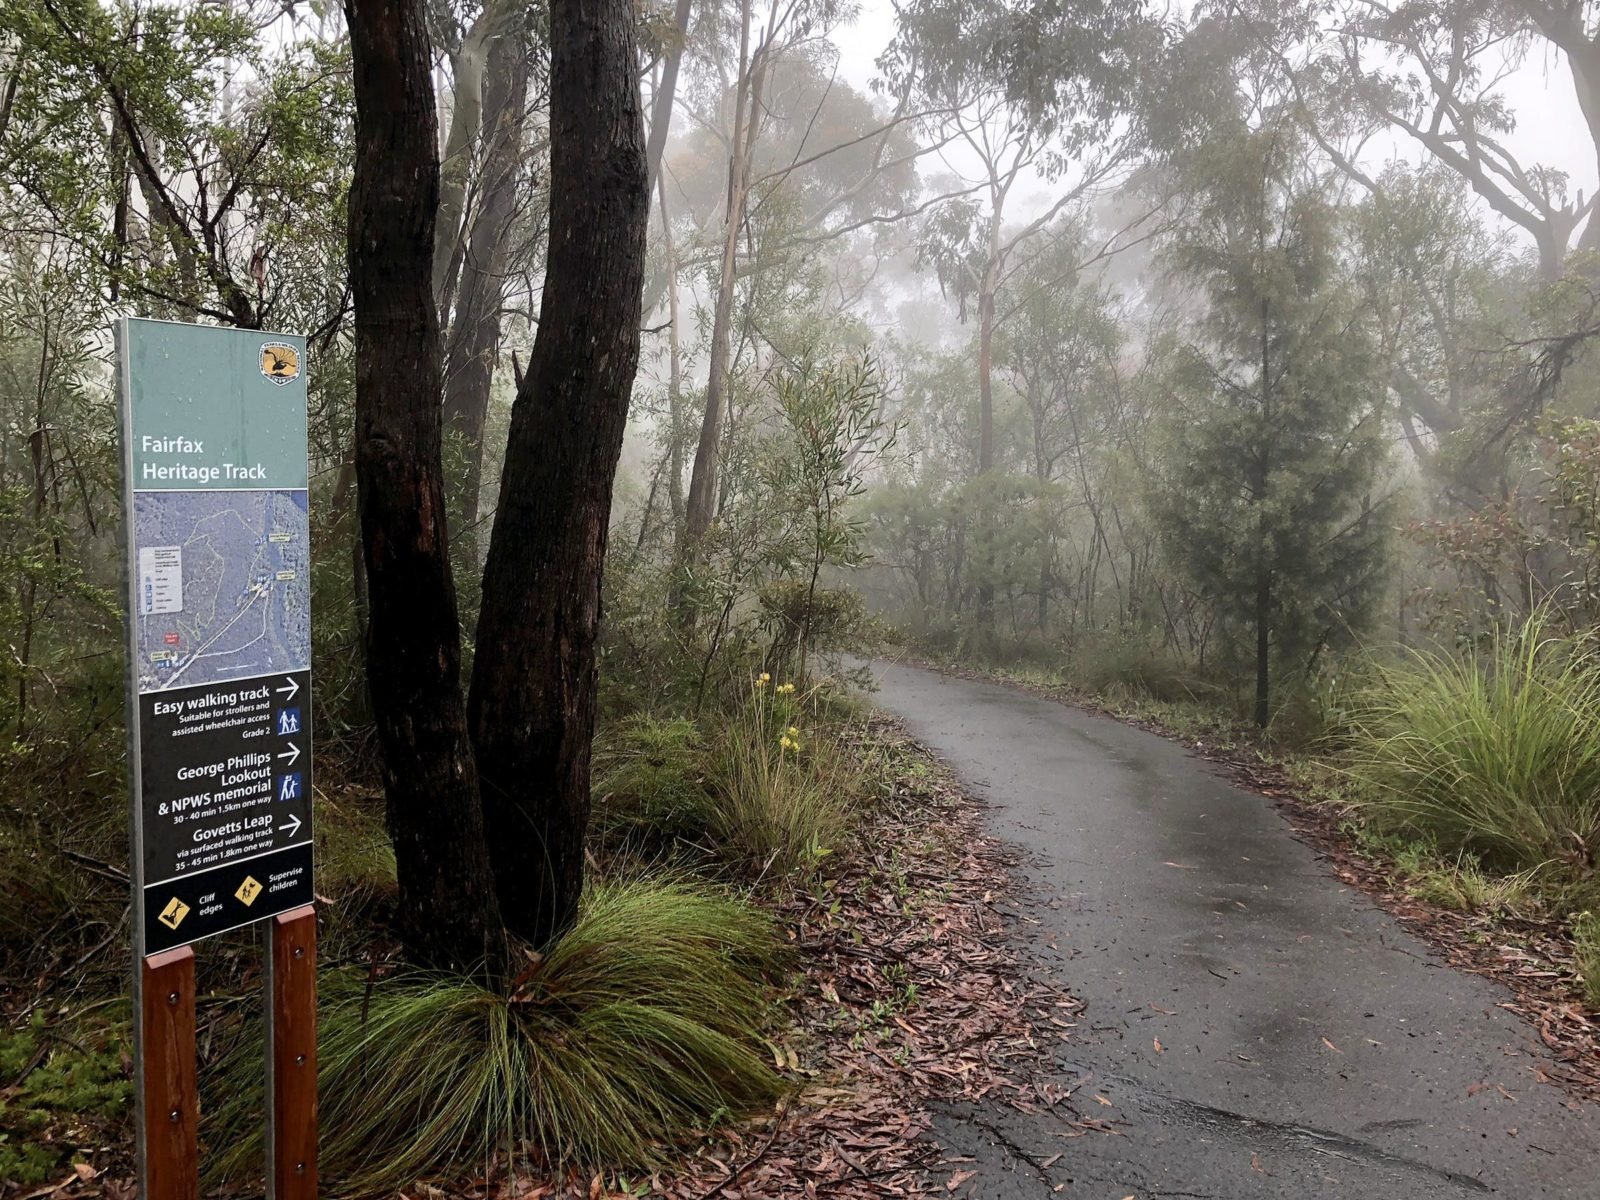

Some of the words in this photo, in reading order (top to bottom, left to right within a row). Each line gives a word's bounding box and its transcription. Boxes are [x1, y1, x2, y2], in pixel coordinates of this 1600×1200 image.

[143, 436, 203, 453] Fairfax
[143, 463, 220, 483] Heritage
[223, 463, 266, 479] Track
[154, 702, 184, 715] Easy
[187, 692, 237, 709] walking
[240, 685, 270, 701] track
[179, 710, 212, 723] Suitable
[213, 709, 223, 717] for
[225, 704, 254, 715] strollers
[256, 701, 270, 711] and
[172, 724, 204, 737] assisted
[205, 717, 246, 731] wheelchair
[247, 714, 270, 723] access
[242, 728, 265, 739] Grade
[265, 727, 270, 735] 2
[177, 762, 225, 780] George
[227, 753, 271, 770] Phillips
[221, 766, 271, 786] Lookout
[158, 802, 169, 816] &
[172, 793, 211, 813] NPWS
[214, 779, 271, 803] memorial
[173, 816, 184, 825] 30
[189, 811, 200, 820] 40
[201, 808, 216, 818] min
[218, 803, 240, 815] 1.5km
[242, 800, 256, 808] one
[257, 795, 272, 805] way
[193, 821, 241, 842] Govetts
[244, 814, 273, 830] Leap
[177, 849, 189, 859] via
[190, 841, 223, 856] surfaced
[225, 833, 253, 846] walking
[255, 827, 273, 838] track
[175, 862, 185, 871] 35
[191, 857, 201, 866] 45
[203, 854, 218, 864] min
[220, 849, 242, 859] 1.8km
[243, 845, 258, 853] one
[259, 839, 273, 848] way
[268, 867, 303, 883] Supervise
[268, 879, 297, 893] children
[199, 893, 216, 904] Cliff
[199, 903, 223, 916] edges
